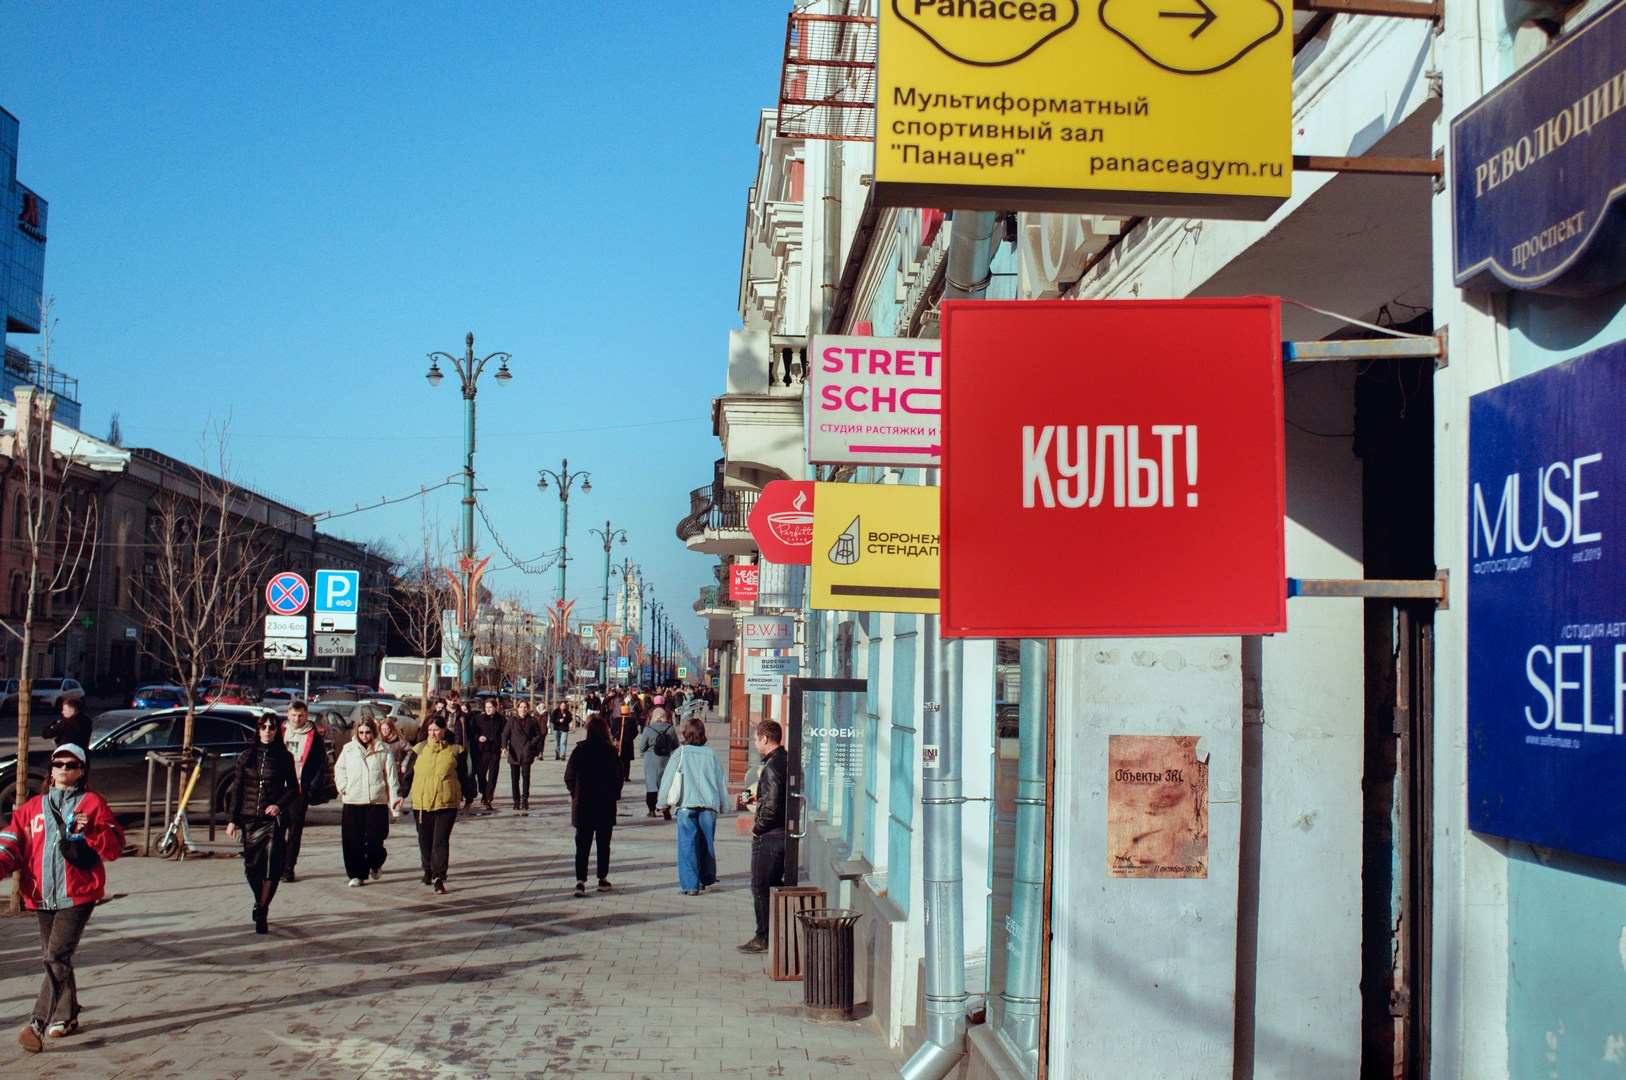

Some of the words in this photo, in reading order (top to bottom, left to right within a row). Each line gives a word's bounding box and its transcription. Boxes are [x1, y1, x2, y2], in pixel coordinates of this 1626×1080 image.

[914, 0, 1057, 21] Panacea
[893, 87, 1149, 117] Мультиформатный
[892, 119, 1053, 142] спортивный
[1060, 125, 1104, 143] зал
[891, 144, 1025, 168] "Панацея"
[1090, 154, 1283, 179] panaceagym.ru
[1511, 211, 1585, 270] проспект
[822, 347, 941, 376] STRET
[820, 424, 862, 434] СТУДИЯ
[866, 425, 925, 435] РАСТЯЖКИ
[928, 427, 936, 436] И
[1023, 425, 1198, 508] КУЛЬТ!
[1473, 453, 1602, 558] MUSE
[867, 544, 939, 557] СТЕНДАП
[1115, 769, 1162, 781] Объекты
